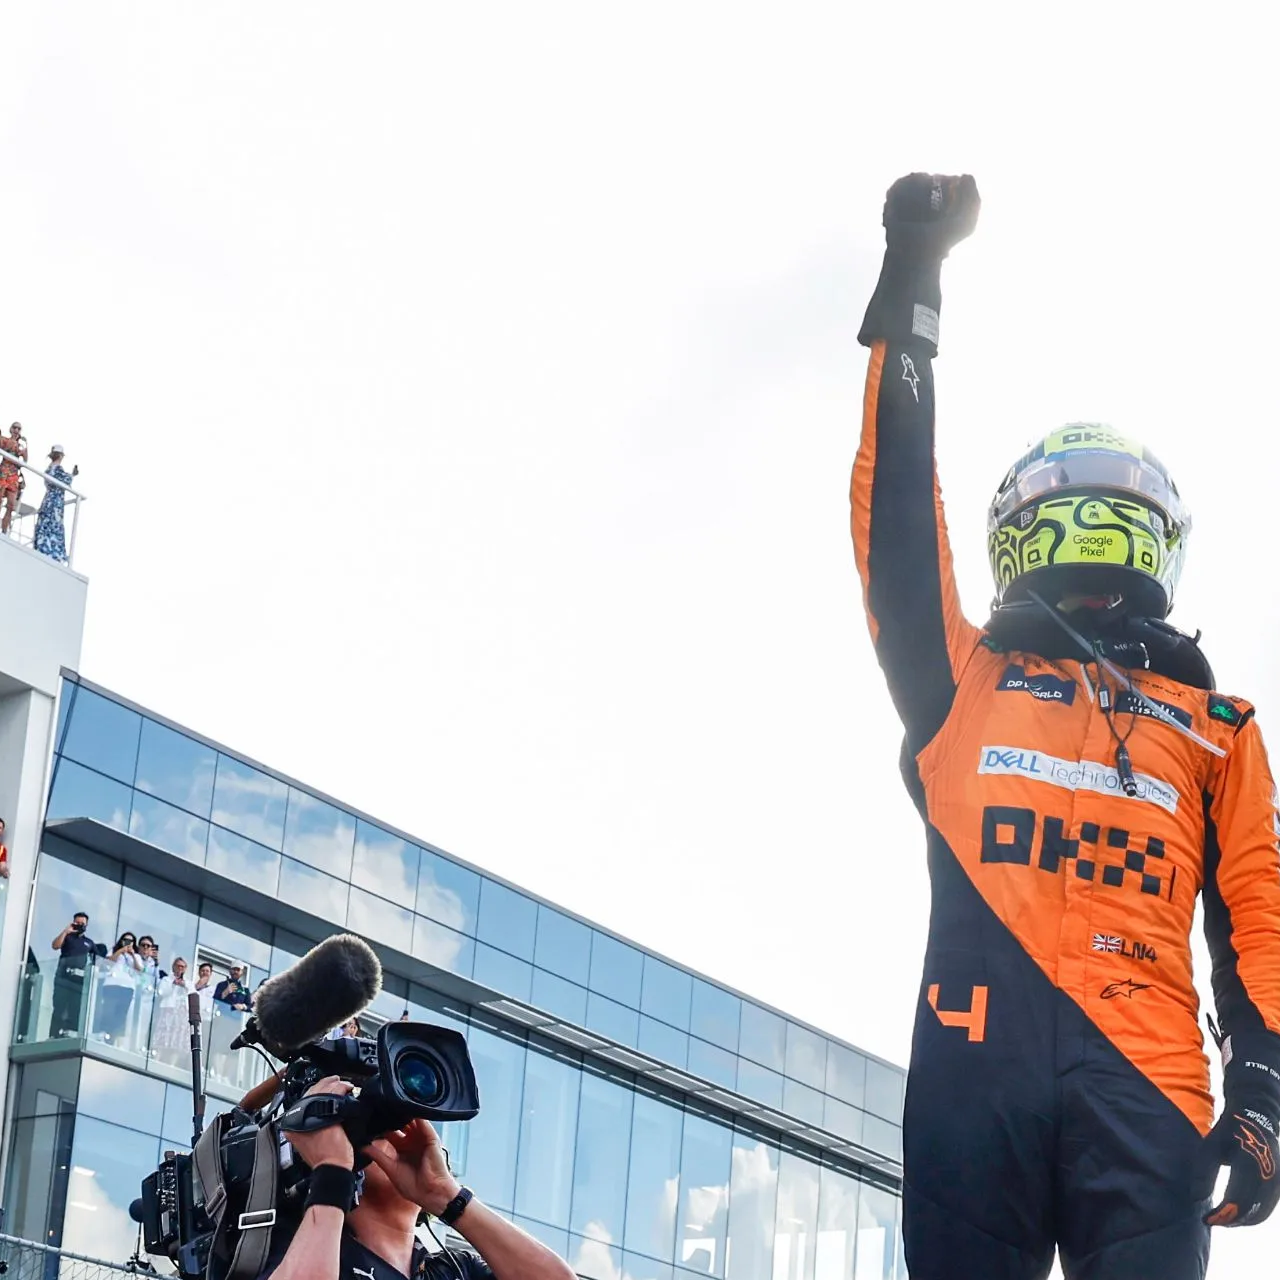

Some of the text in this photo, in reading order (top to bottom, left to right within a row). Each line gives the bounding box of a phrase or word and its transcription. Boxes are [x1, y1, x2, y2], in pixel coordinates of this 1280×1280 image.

[1073, 535, 1113, 547] Google
[1080, 546, 1105, 557] Pixel
[985, 750, 1172, 805] DELL Technogies
[980, 805, 1166, 894] OKX
[1120, 939, 1158, 962] LN4
[928, 984, 987, 1042] 4
